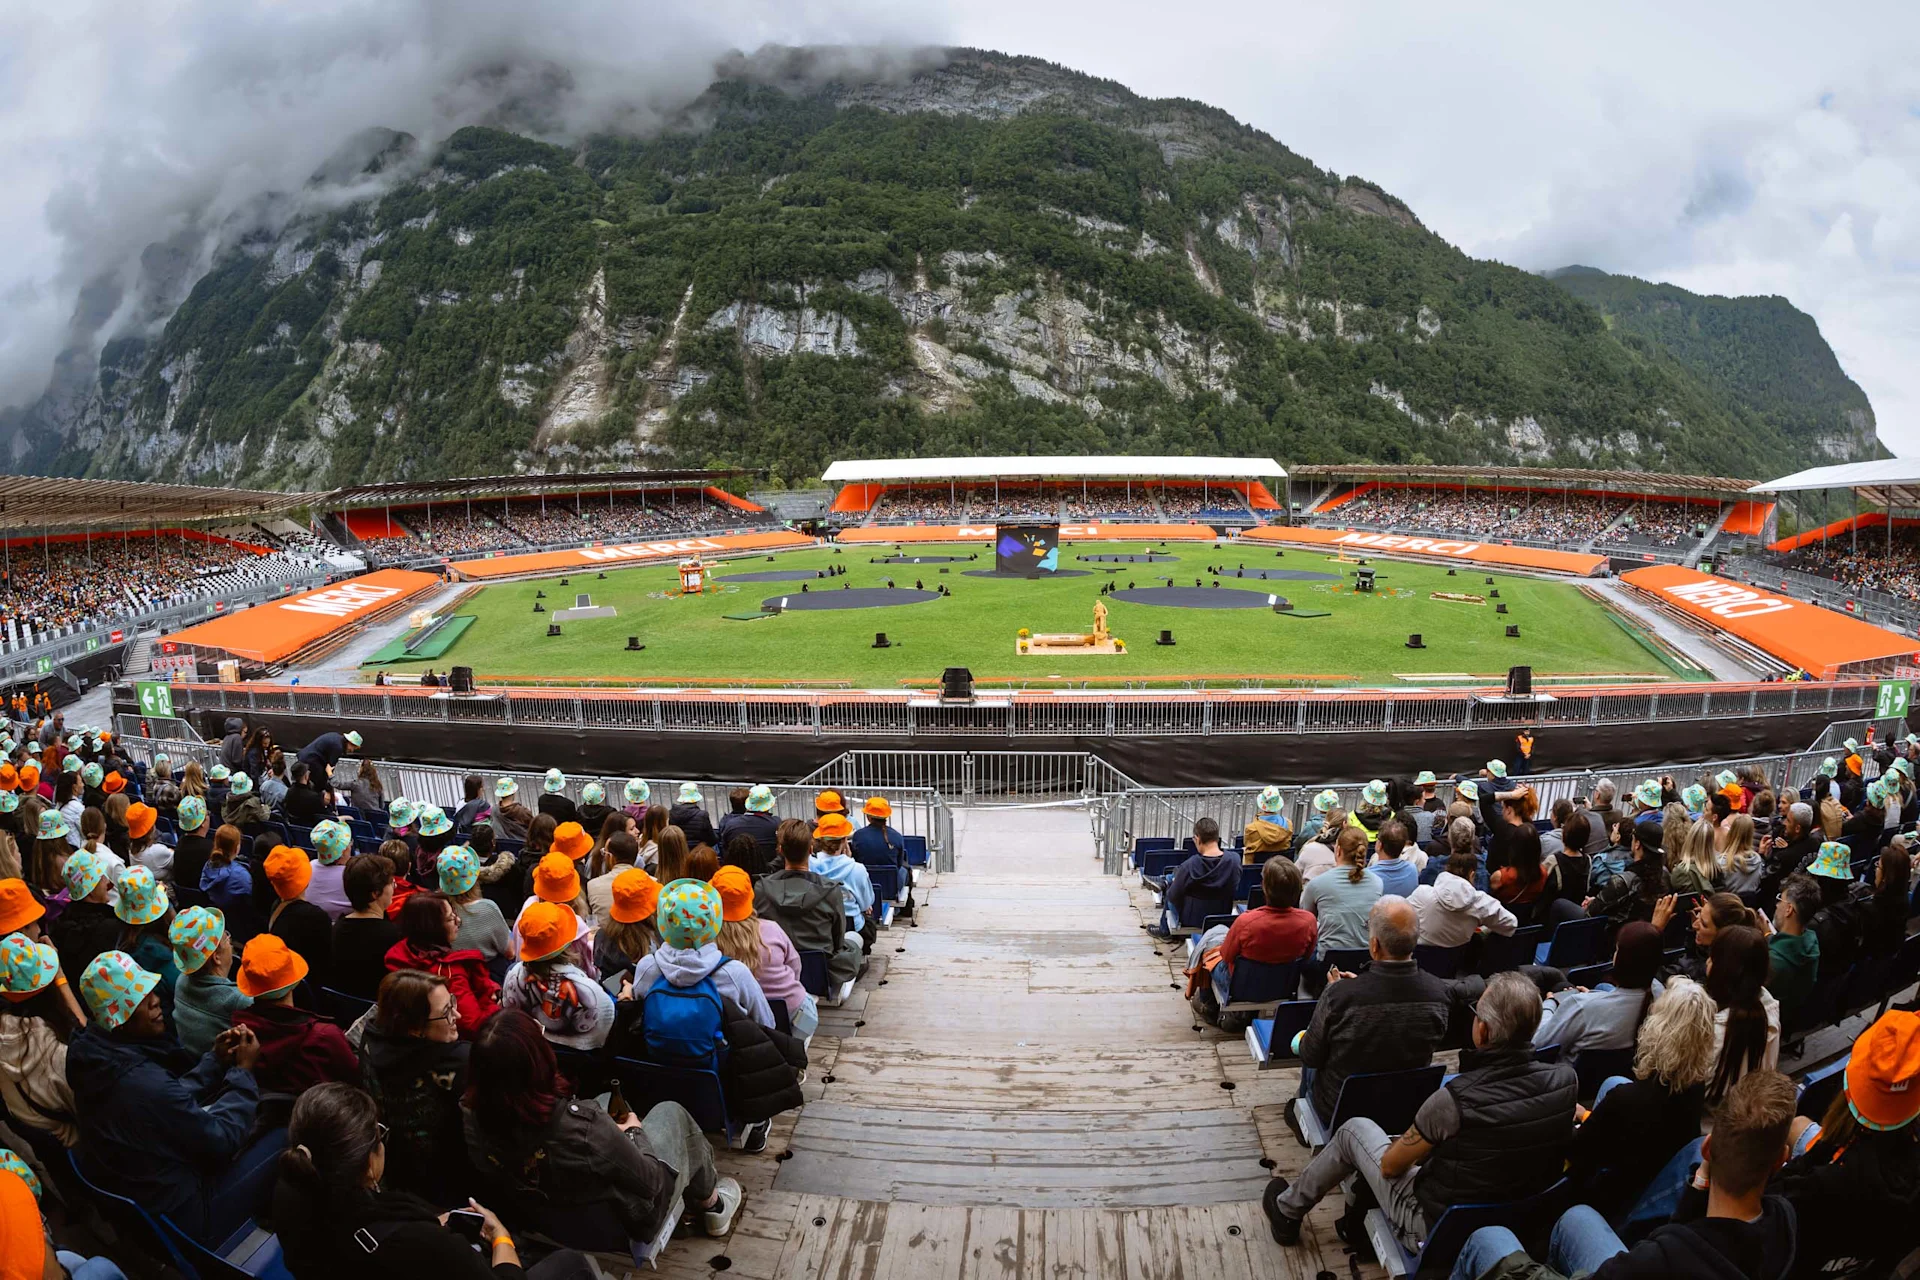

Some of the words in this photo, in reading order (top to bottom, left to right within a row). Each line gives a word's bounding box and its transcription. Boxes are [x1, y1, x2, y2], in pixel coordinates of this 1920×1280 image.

[958, 527, 1098, 536] MCI
[578, 540, 724, 560] MERCI
[1331, 533, 1480, 555] MERCI
[278, 583, 403, 617] MERCI
[1662, 580, 1794, 618] MERCI
